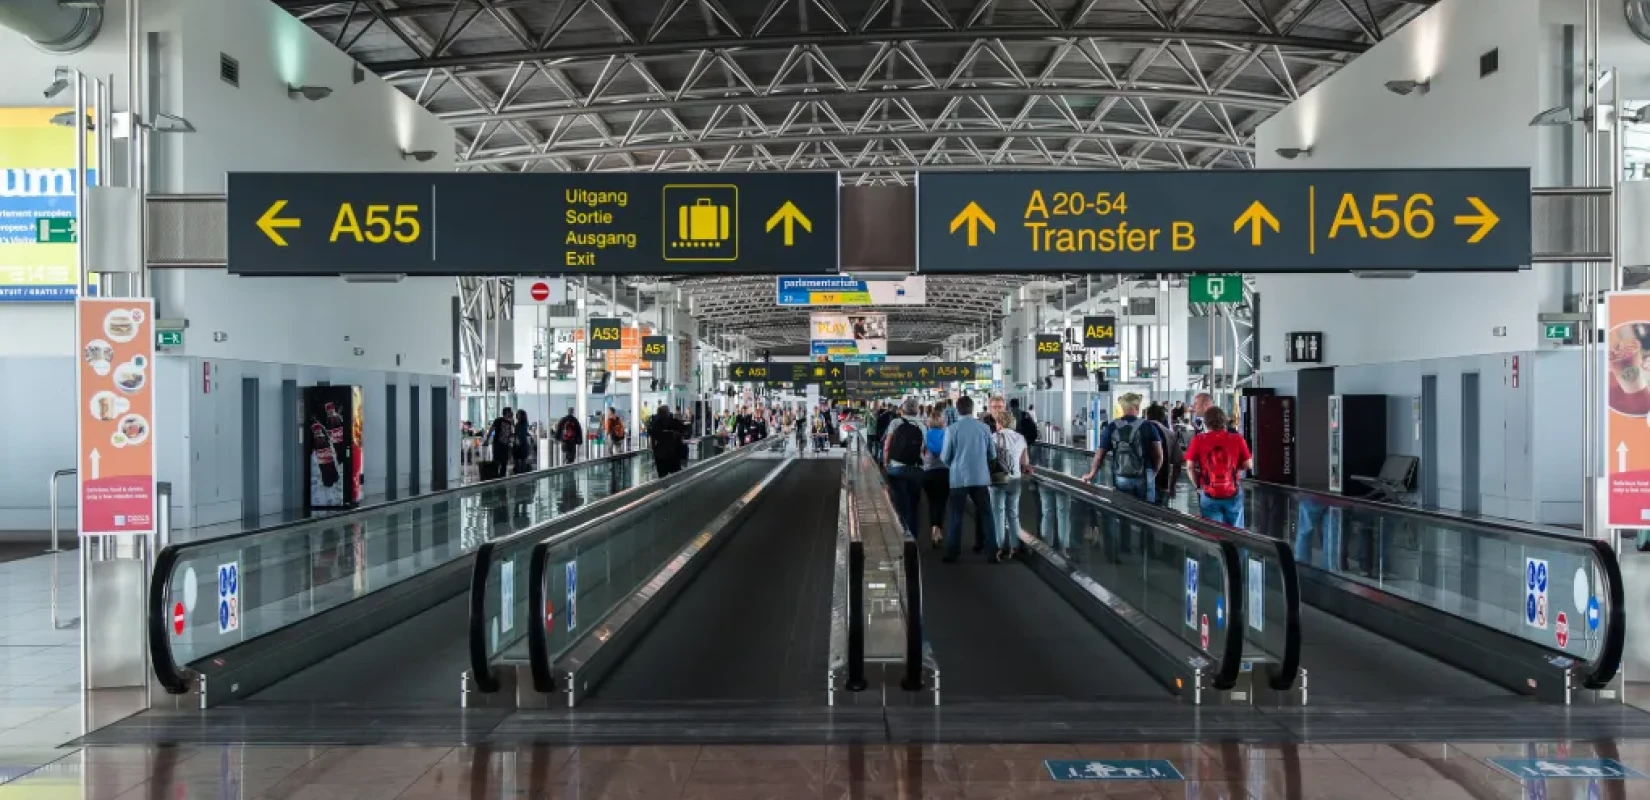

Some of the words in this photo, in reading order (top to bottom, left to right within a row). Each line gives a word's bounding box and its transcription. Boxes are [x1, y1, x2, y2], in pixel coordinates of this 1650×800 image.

[565, 189, 628, 207] Uitgang
[329, 203, 421, 243] A55
[565, 210, 613, 224] Sortie
[1328, 193, 1435, 239] A56
[565, 231, 637, 248] Ausgang
[1024, 221, 1160, 252] Transfer
[1172, 221, 1196, 251] B
[565, 251, 595, 266] Exit
[784, 277, 858, 290] parlamentarium
[592, 327, 619, 340] A53
[1086, 325, 1113, 339] A54
[645, 343, 665, 354] A51
[1038, 341, 1060, 352] A52
[749, 367, 767, 376] A53
